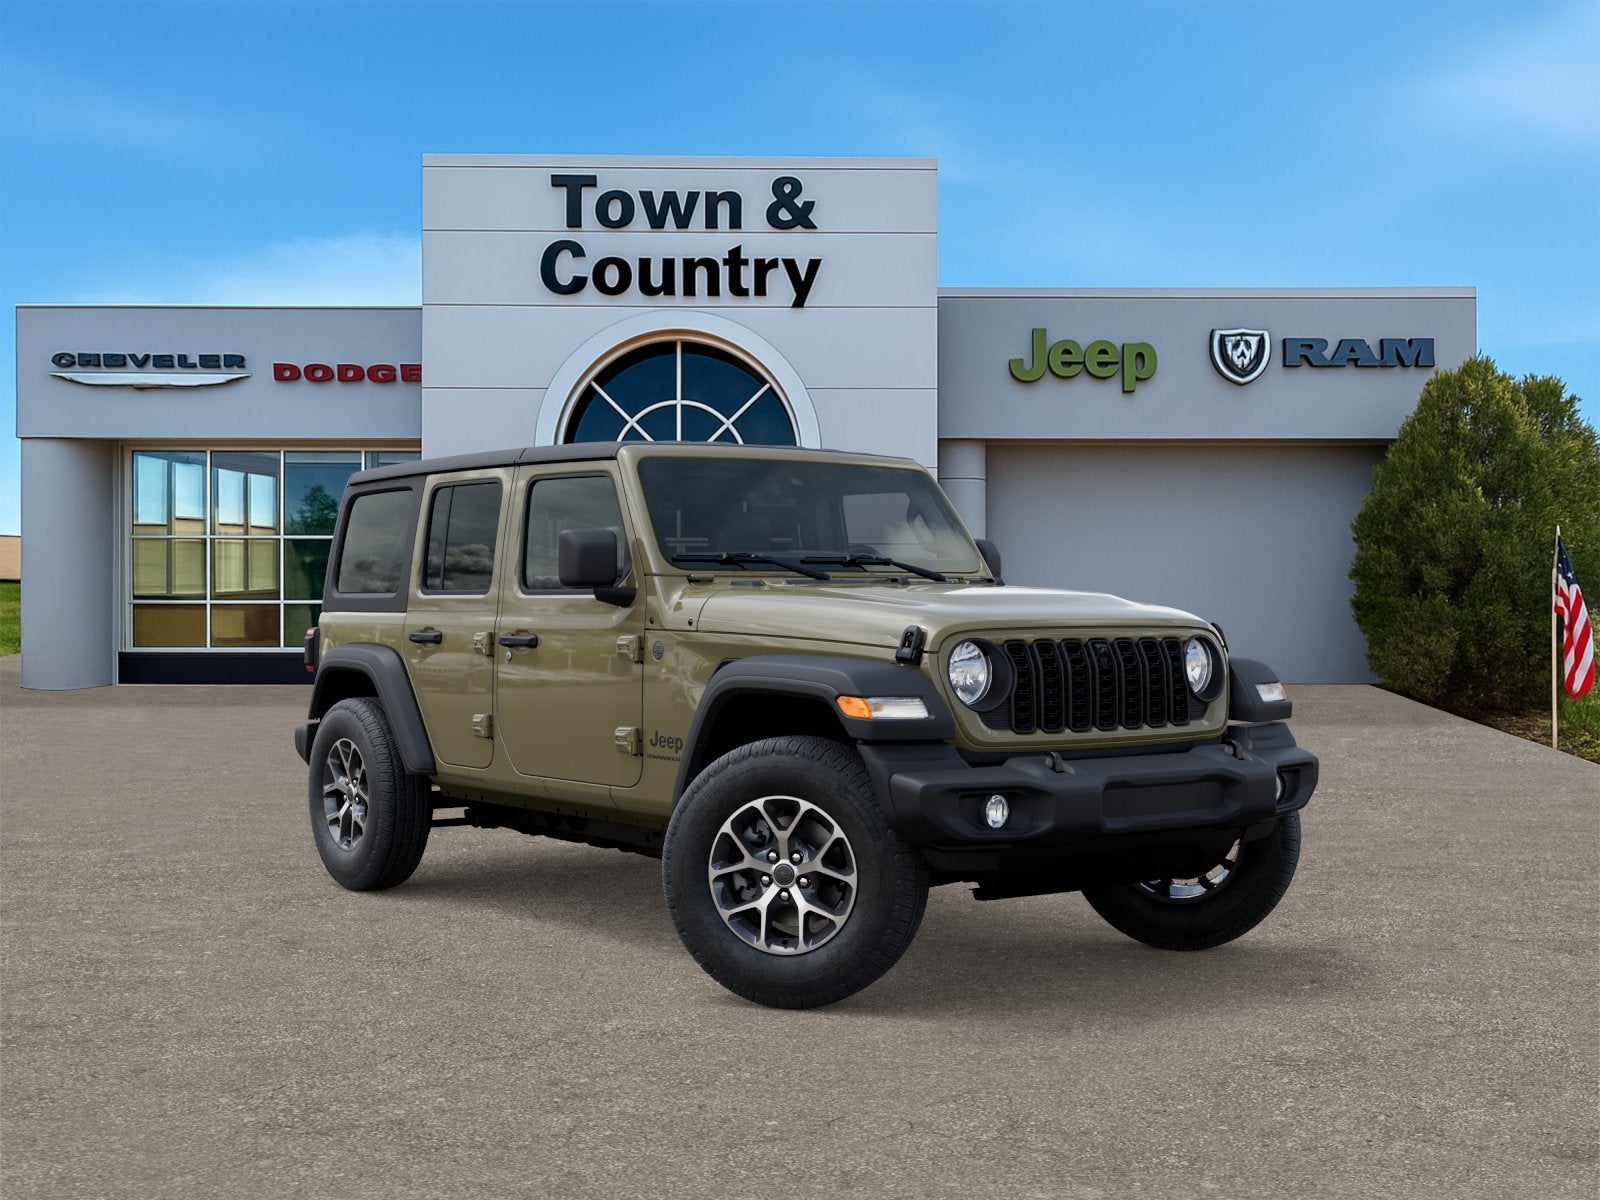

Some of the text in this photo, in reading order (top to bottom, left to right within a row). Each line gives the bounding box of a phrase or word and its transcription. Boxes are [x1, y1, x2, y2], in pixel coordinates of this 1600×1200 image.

[551, 174, 817, 229] Town &
[540, 240, 822, 308] Country
[273, 363, 422, 383] DODGE
[1009, 328, 1157, 393] Jeep
[1282, 337, 1435, 367] RAM
[650, 730, 684, 753] Jeep
